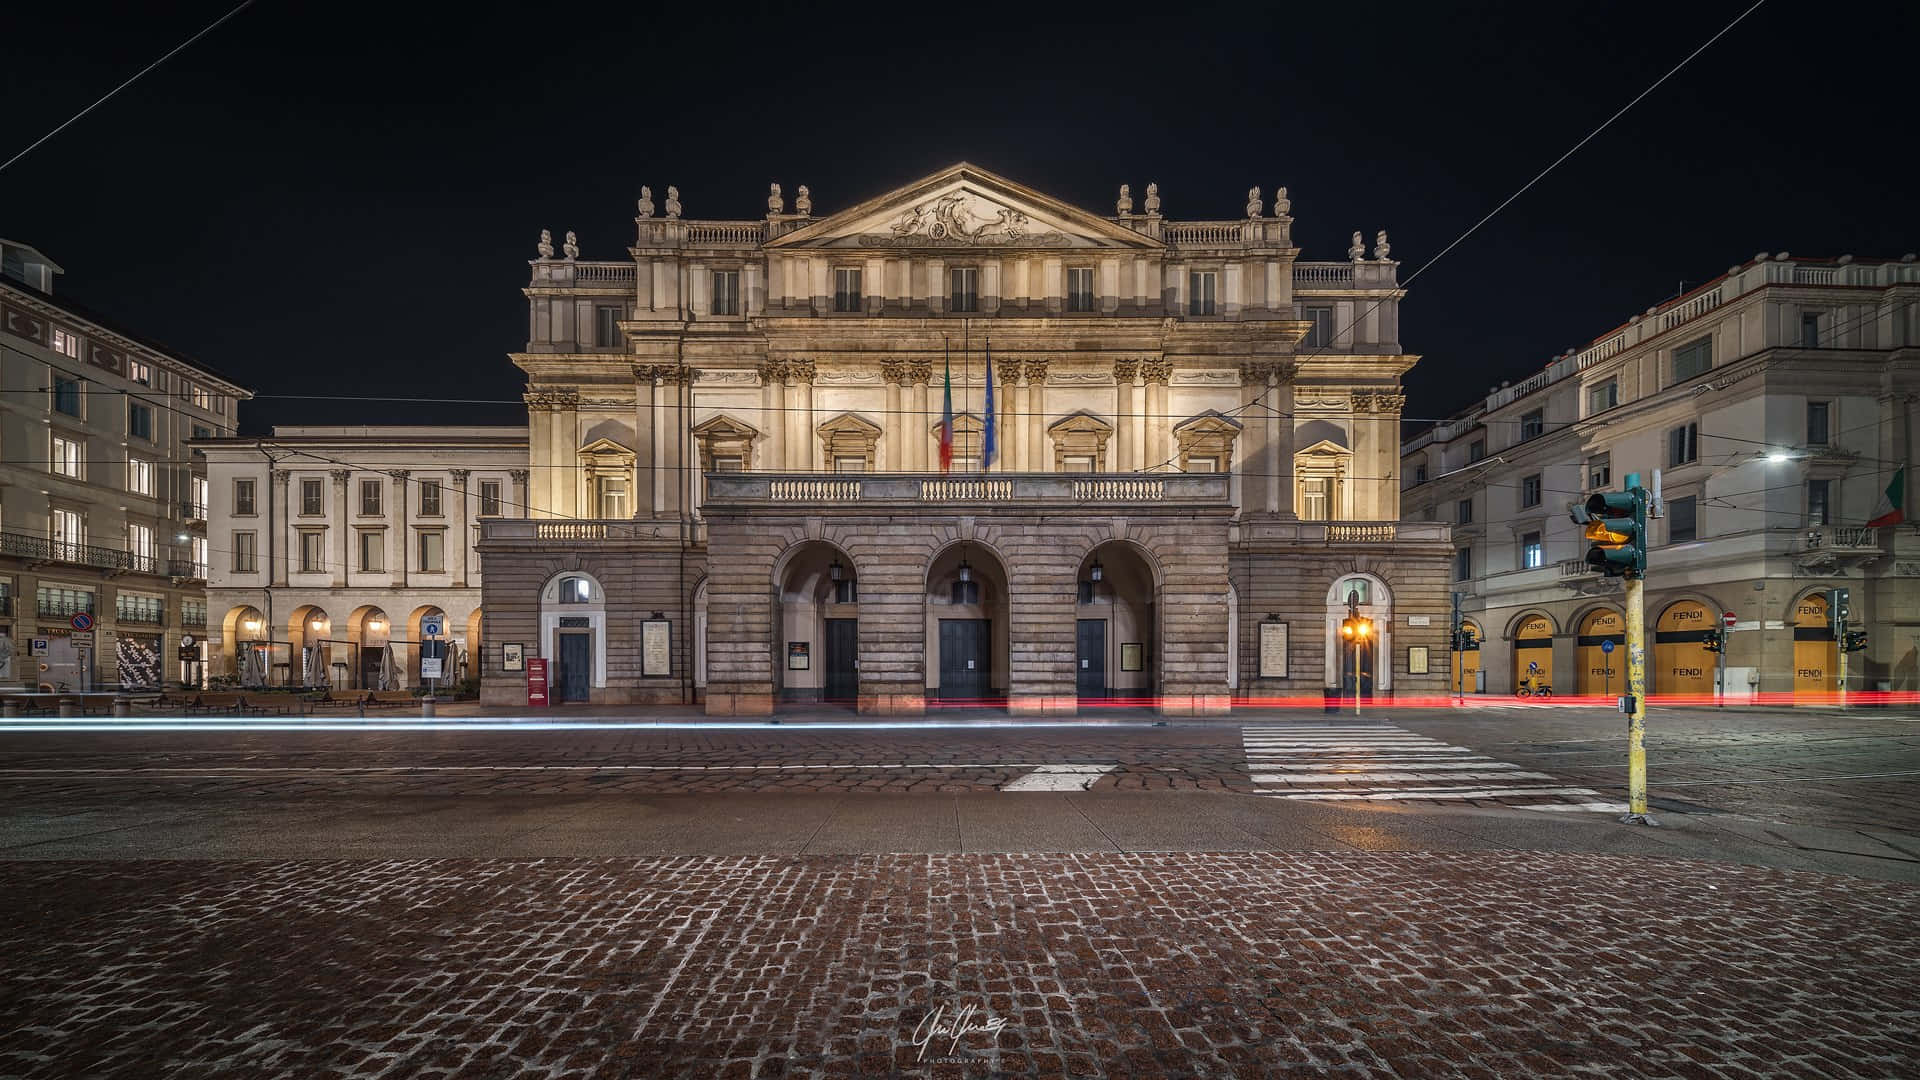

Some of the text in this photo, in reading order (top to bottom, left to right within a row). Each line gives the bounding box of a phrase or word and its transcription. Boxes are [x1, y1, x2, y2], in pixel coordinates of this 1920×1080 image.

[1673, 610, 1703, 620] FENDI
[1798, 606, 1823, 615] FENDI
[1591, 616, 1616, 626] FENDI
[1591, 668, 1616, 676] FENDI
[1672, 668, 1703, 677] FENDI
[1798, 669, 1823, 678] FENDI
